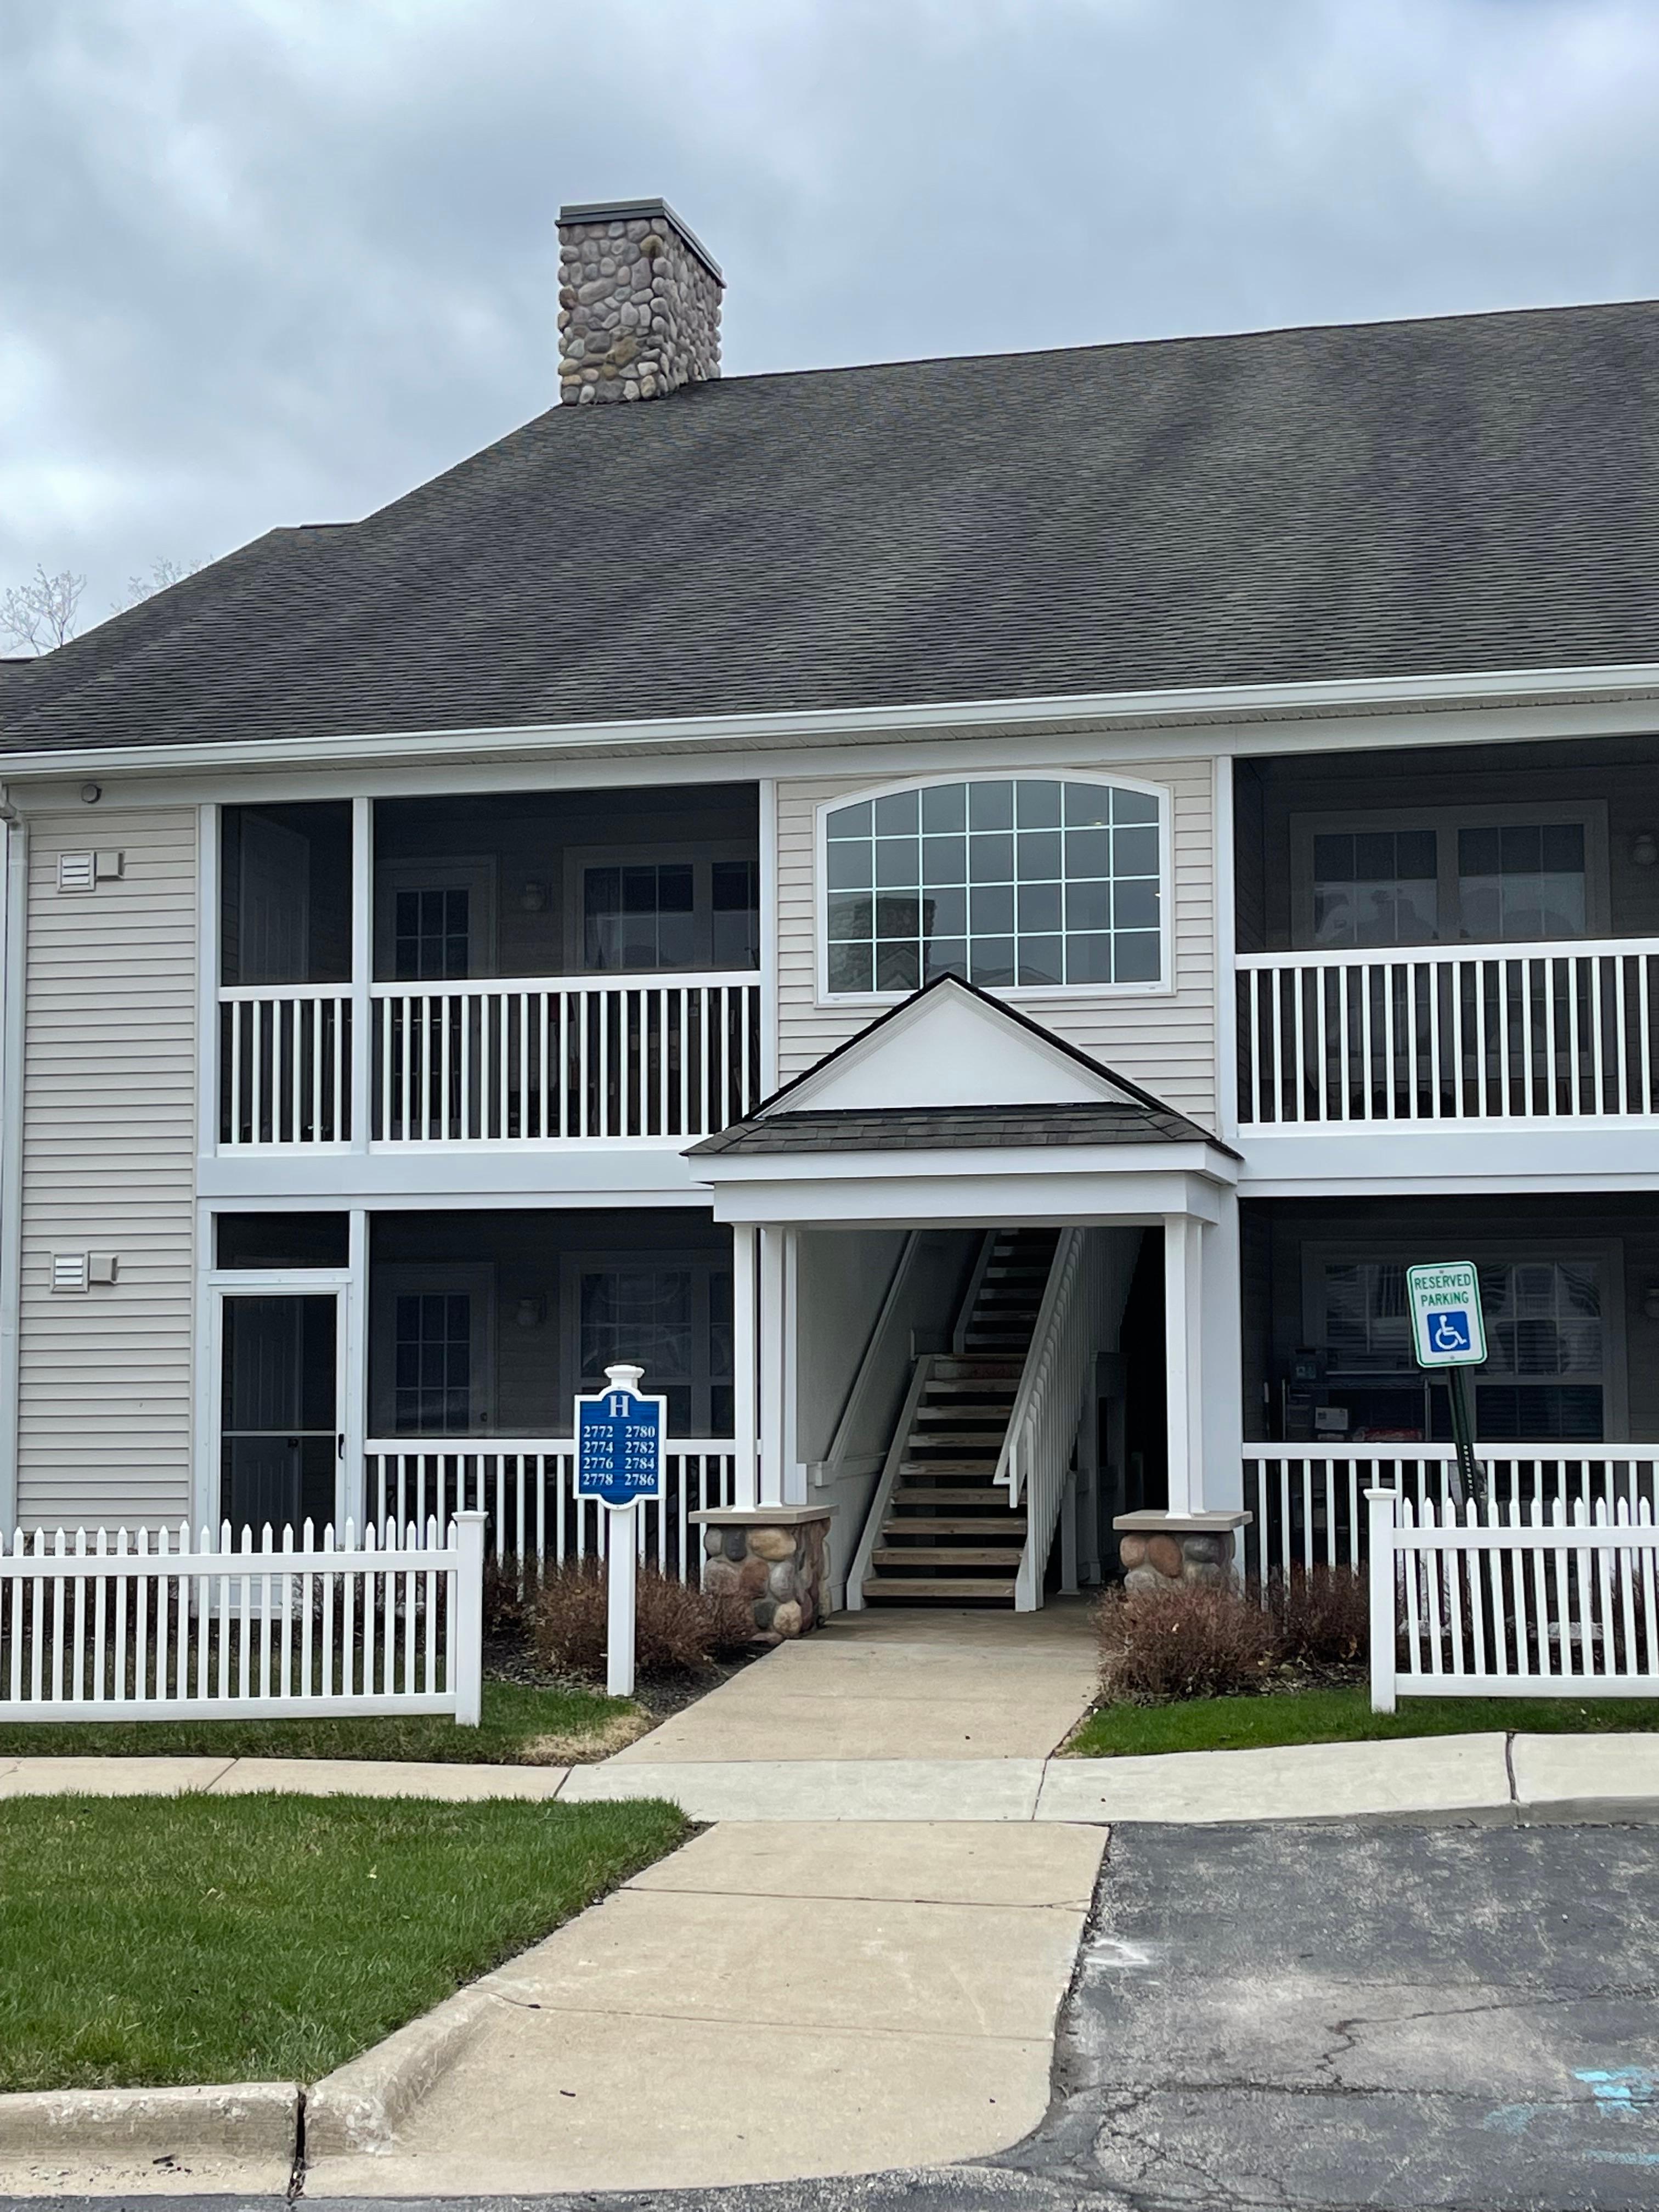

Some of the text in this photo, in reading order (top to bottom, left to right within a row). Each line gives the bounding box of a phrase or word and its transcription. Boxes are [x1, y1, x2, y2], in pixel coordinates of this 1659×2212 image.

[1414, 1273, 1471, 1290] RESERVED
[1421, 1291, 1469, 1307] PARKING
[608, 1395, 630, 1417] H
[583, 1426, 613, 1437] 2772
[625, 1426, 655, 1437] 2780
[583, 1442, 613, 1453] 2774
[625, 1442, 655, 1453] 2782
[583, 1458, 613, 1469] 2776
[624, 1458, 654, 1469] 2784
[583, 1474, 613, 1485] 2778
[624, 1474, 654, 1486] 2786
